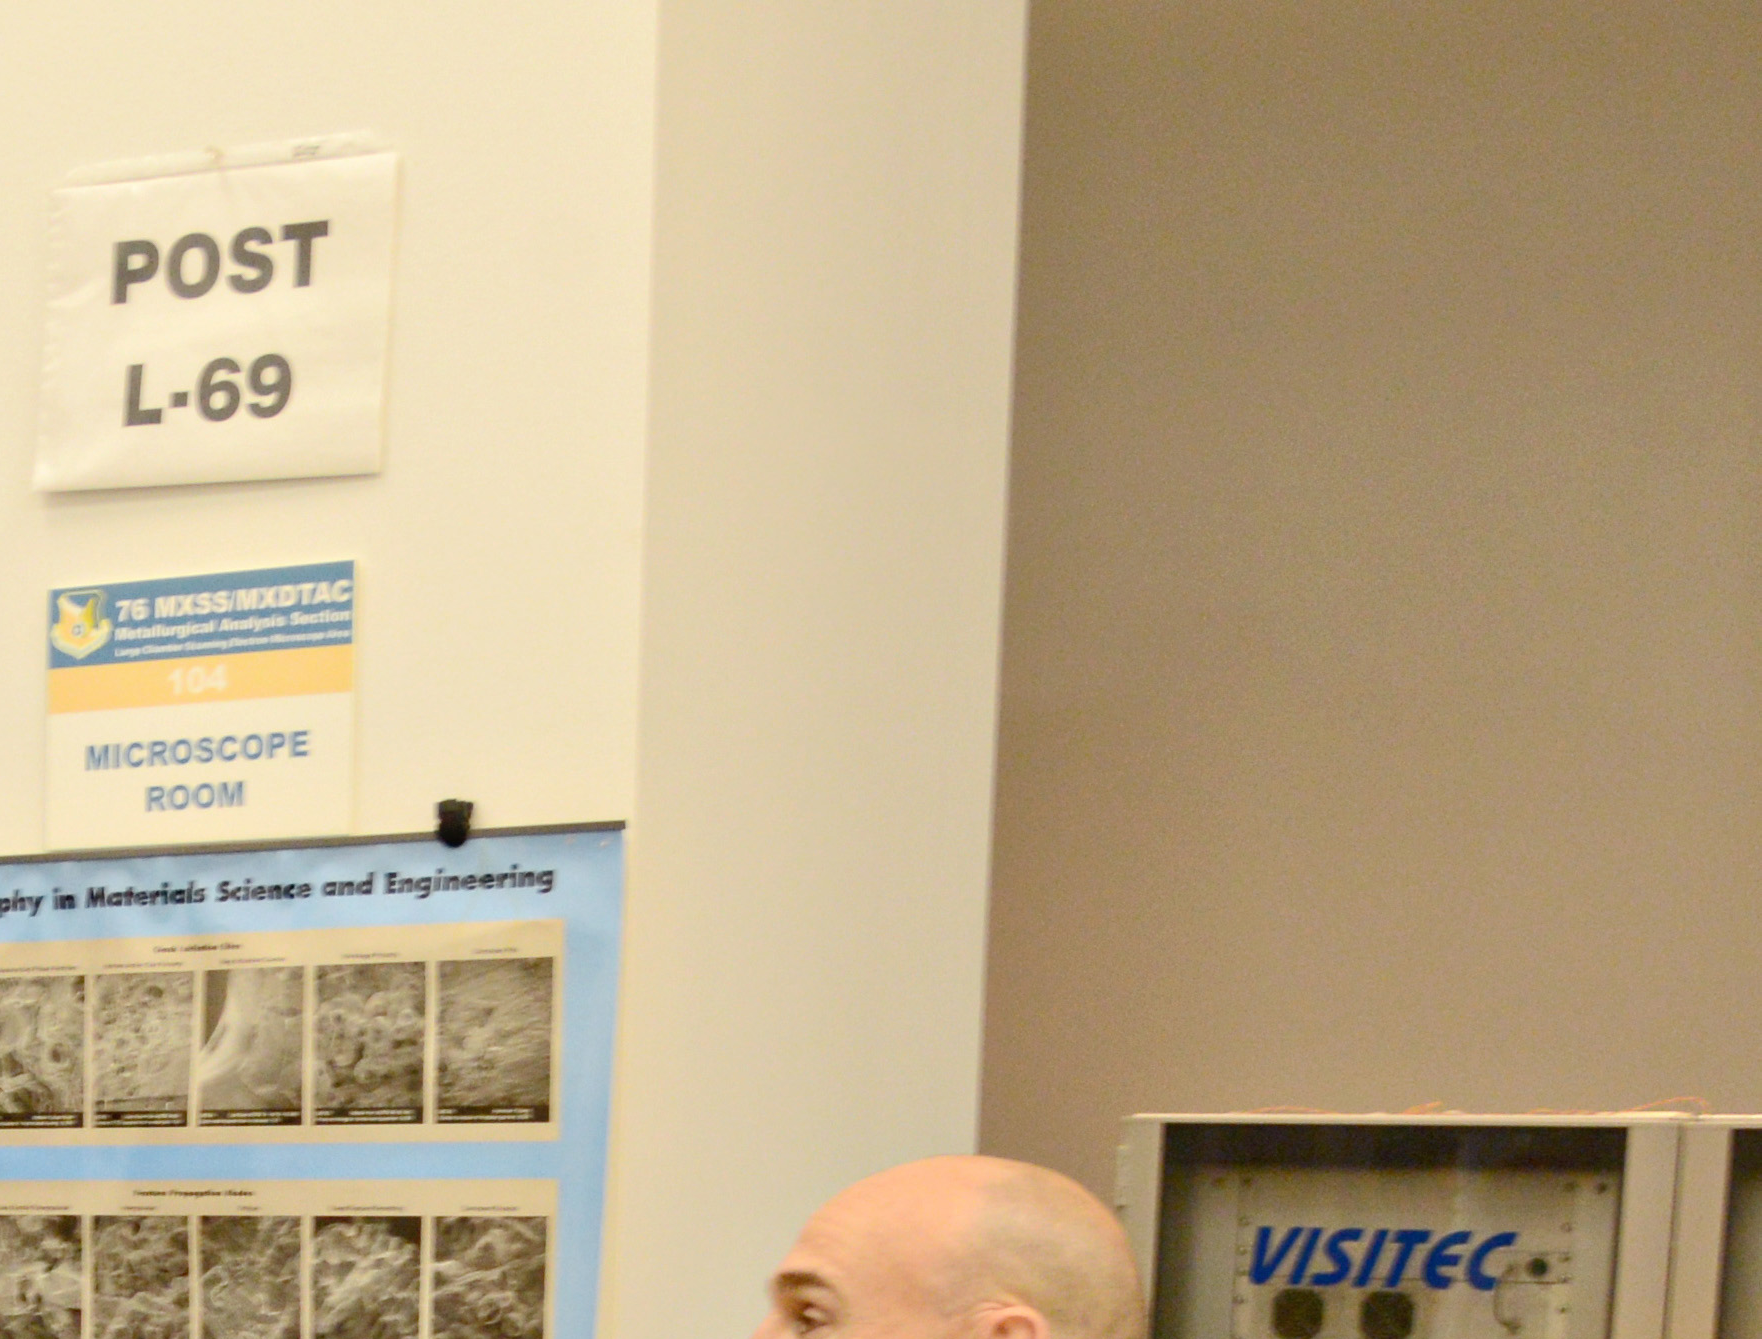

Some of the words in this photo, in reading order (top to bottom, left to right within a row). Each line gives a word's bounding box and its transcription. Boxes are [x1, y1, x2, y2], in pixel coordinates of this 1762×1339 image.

[110, 219, 331, 305] POST
[121, 353, 293, 427] L-69
[116, 599, 149, 621] 76
[154, 579, 353, 618] MXSS/MXDTAC
[115, 620, 214, 640] Metallurgical
[219, 615, 285, 632] Analysis
[290, 609, 350, 625] Section
[169, 664, 227, 695] 104
[85, 731, 309, 770] MICROSCOPE
[145, 782, 245, 811] ROOM
[52, 887, 76, 910] in
[85, 881, 206, 908] Materials
[217, 878, 311, 902] Science
[321, 872, 374, 897] and
[384, 864, 556, 898] Engineering
[1248, 1226, 1519, 1290] VISITEC
